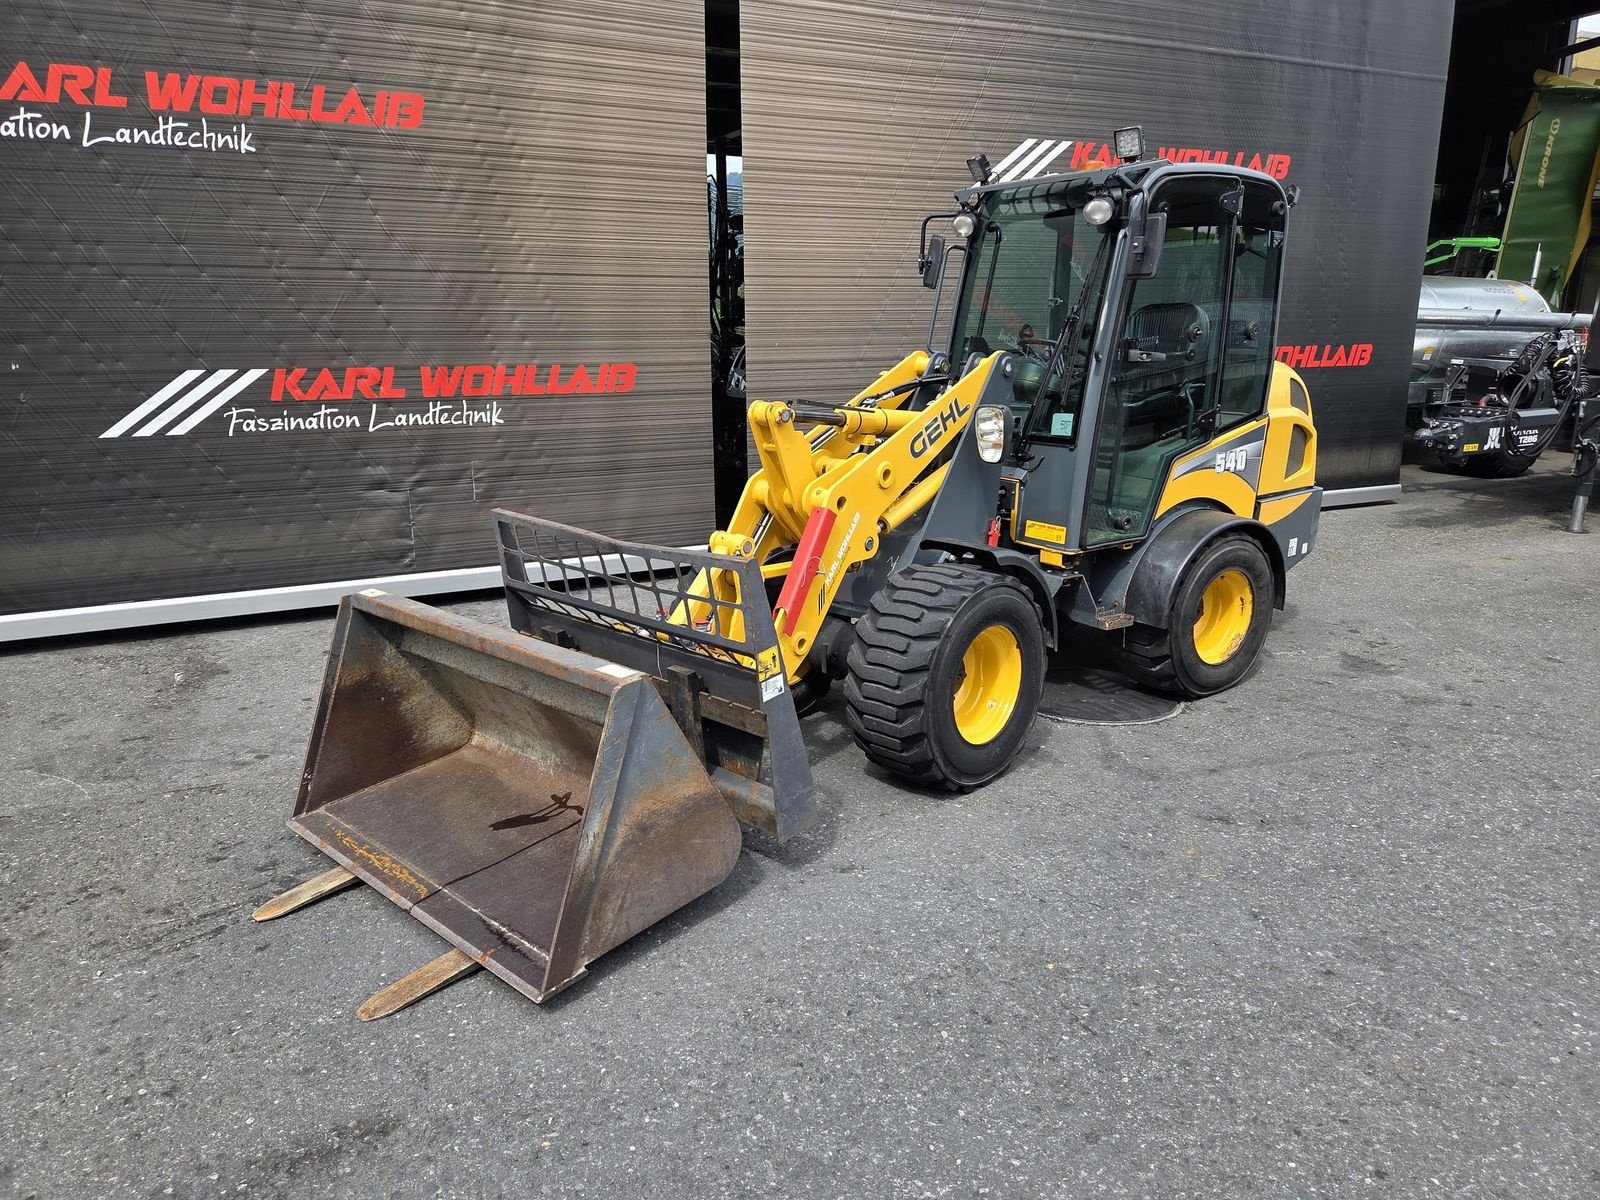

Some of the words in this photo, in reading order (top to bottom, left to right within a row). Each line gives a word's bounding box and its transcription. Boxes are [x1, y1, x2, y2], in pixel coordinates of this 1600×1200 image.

[0, 61, 128, 108] ARL
[145, 71, 426, 129] WOHLLAIB
[0, 106, 71, 140] ation
[82, 111, 257, 153] Landtechnik
[1537, 134, 1555, 189] KRONE
[1275, 343, 1374, 369] OHLLAIB
[270, 366, 406, 402] KARL
[421, 363, 638, 398] WOHLLAIB
[223, 405, 361, 437] Faszination
[368, 400, 505, 433] Landtechnik
[910, 397, 971, 459] GEHL
[1214, 449, 1248, 475] 540
[824, 560, 840, 587] KARL
